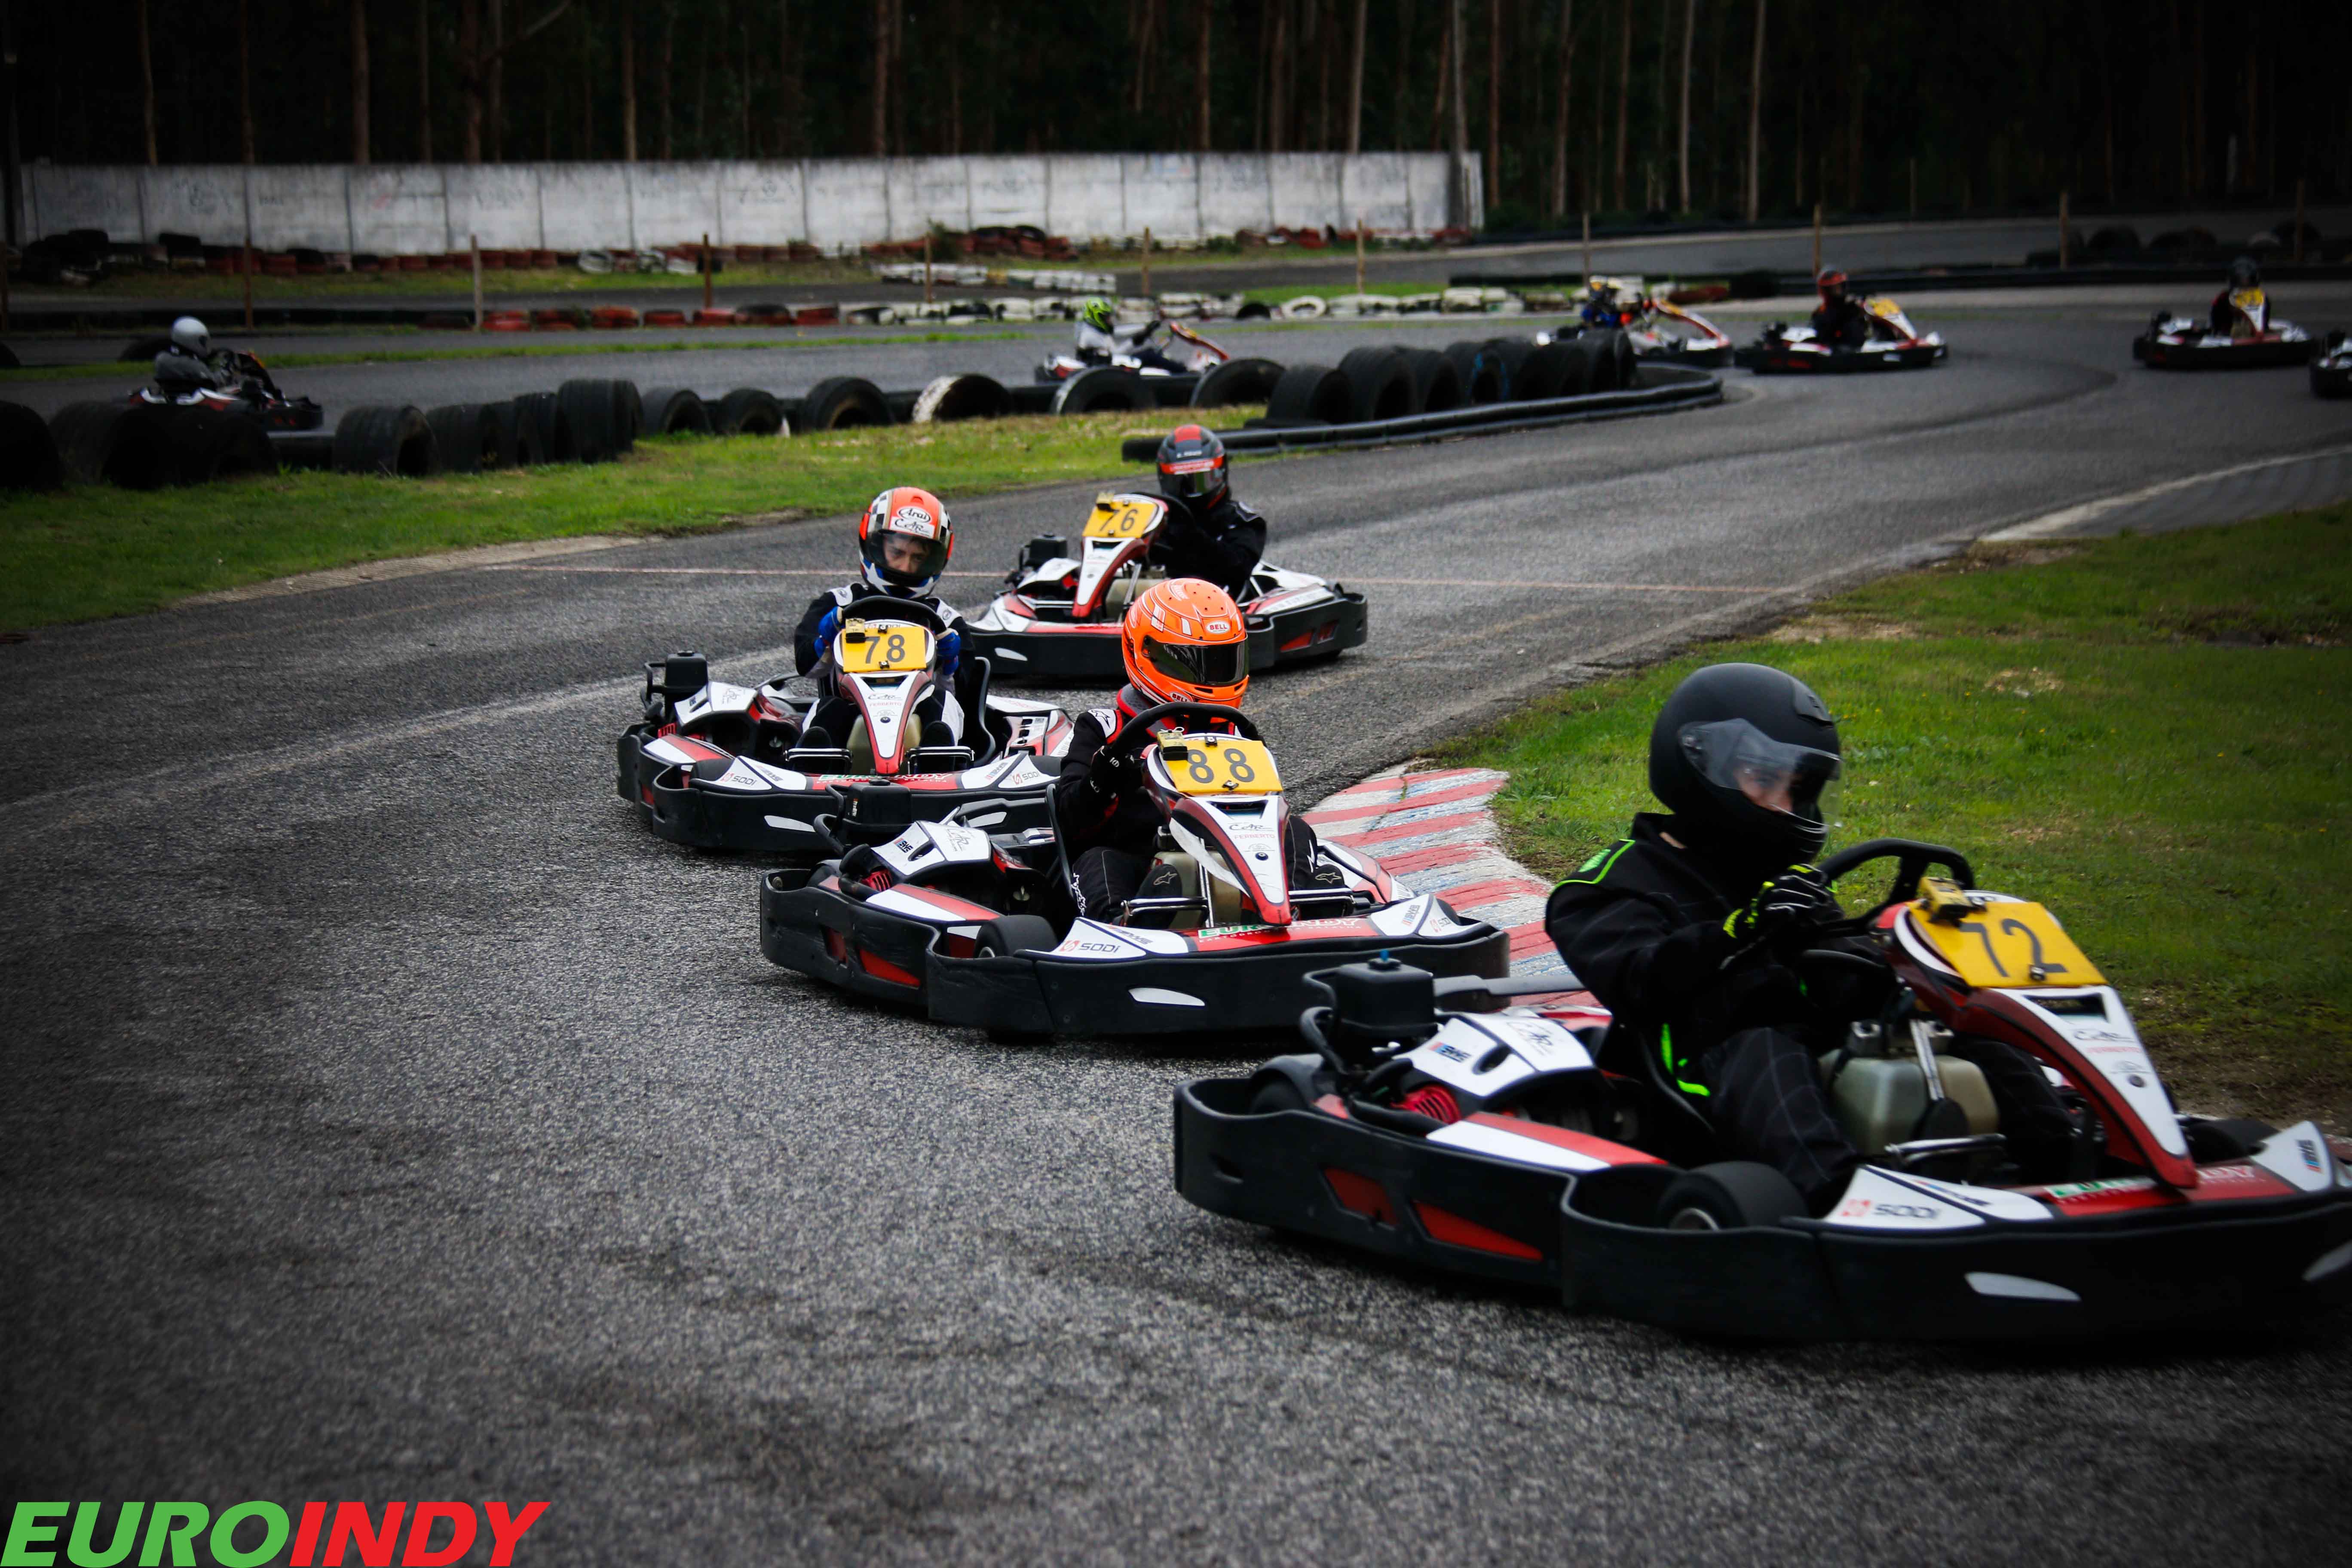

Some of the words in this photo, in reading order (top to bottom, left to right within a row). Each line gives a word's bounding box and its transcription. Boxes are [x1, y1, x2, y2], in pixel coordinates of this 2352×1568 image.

[1099, 508, 1139, 532] 76
[864, 634, 905, 664] 78
[1187, 748, 1255, 784] 88
[732, 775, 757, 786] SODI
[1079, 943, 1121, 953] SODI
[1959, 918, 2070, 977] 72
[1873, 1204, 1941, 1219] SODI
